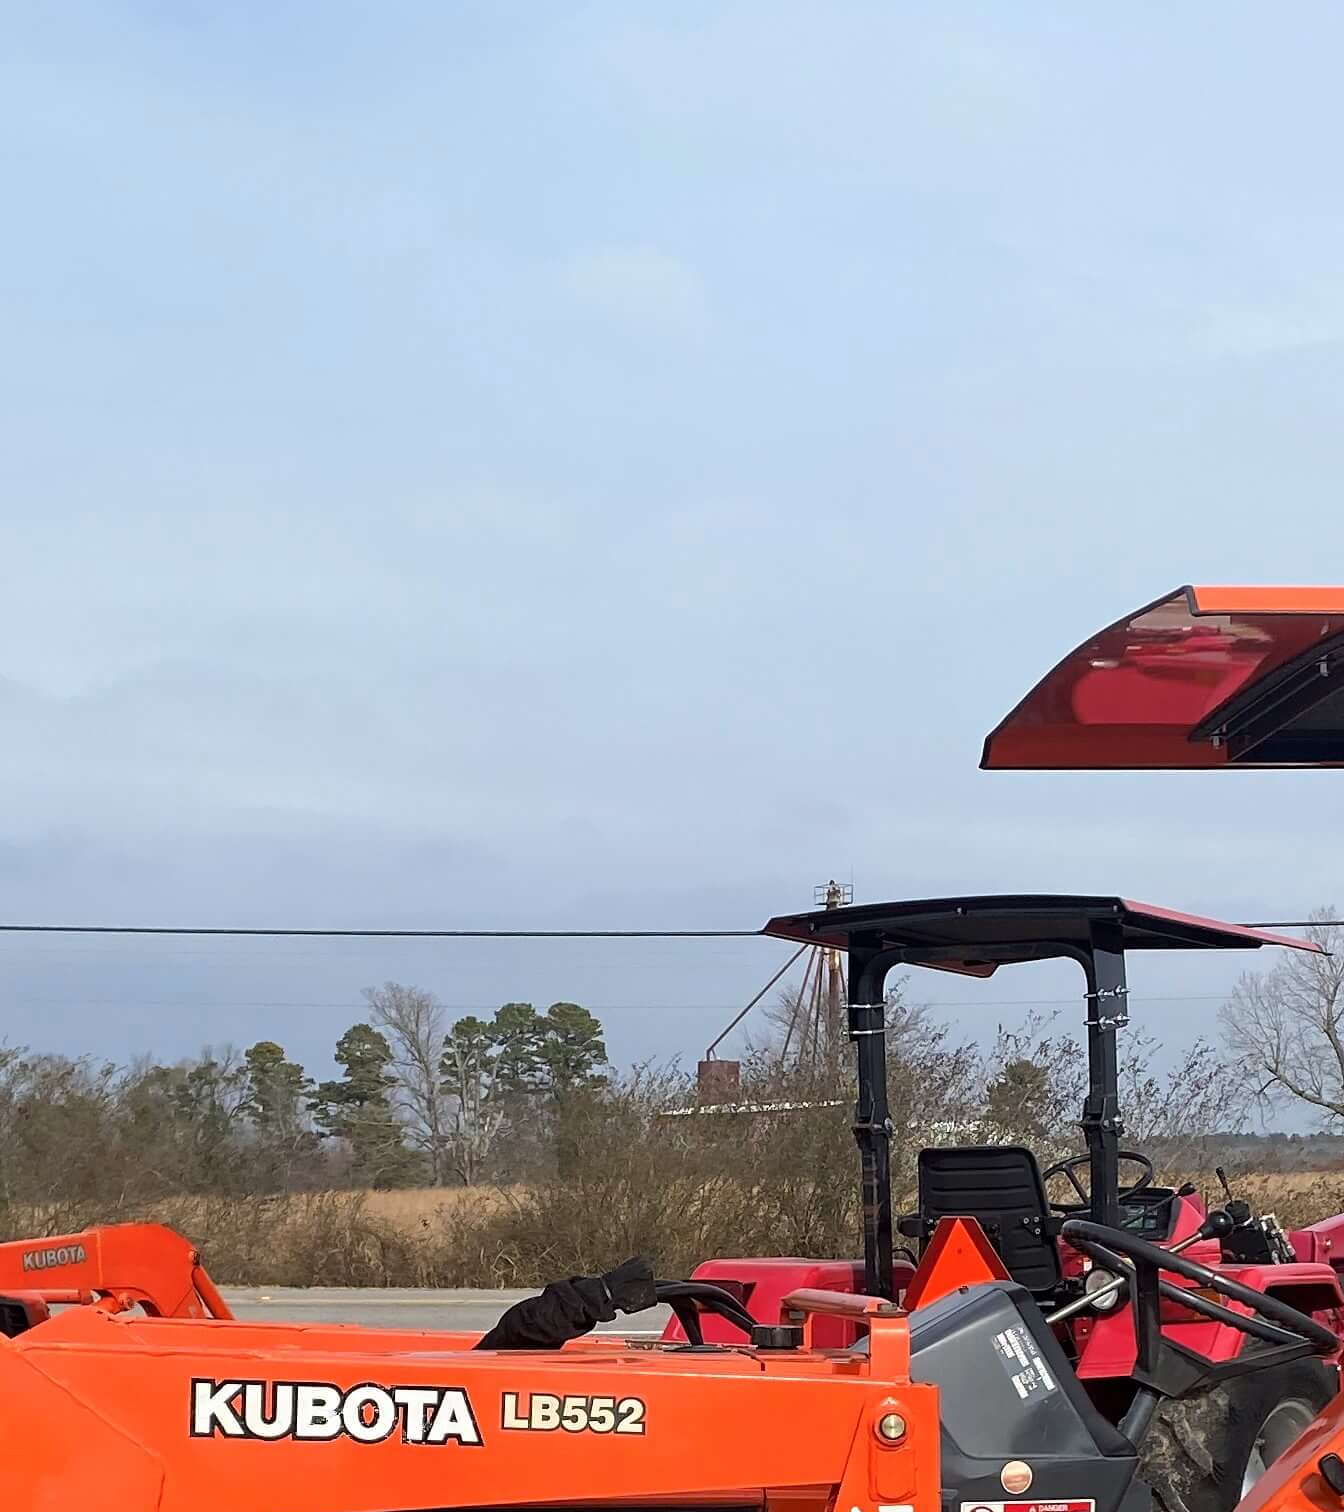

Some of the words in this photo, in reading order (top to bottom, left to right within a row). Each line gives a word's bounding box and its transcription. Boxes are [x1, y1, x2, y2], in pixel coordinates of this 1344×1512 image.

[22, 1245, 87, 1271] KUBOTA
[192, 1379, 483, 1446] KUBOTA
[502, 1392, 646, 1435] LB552
